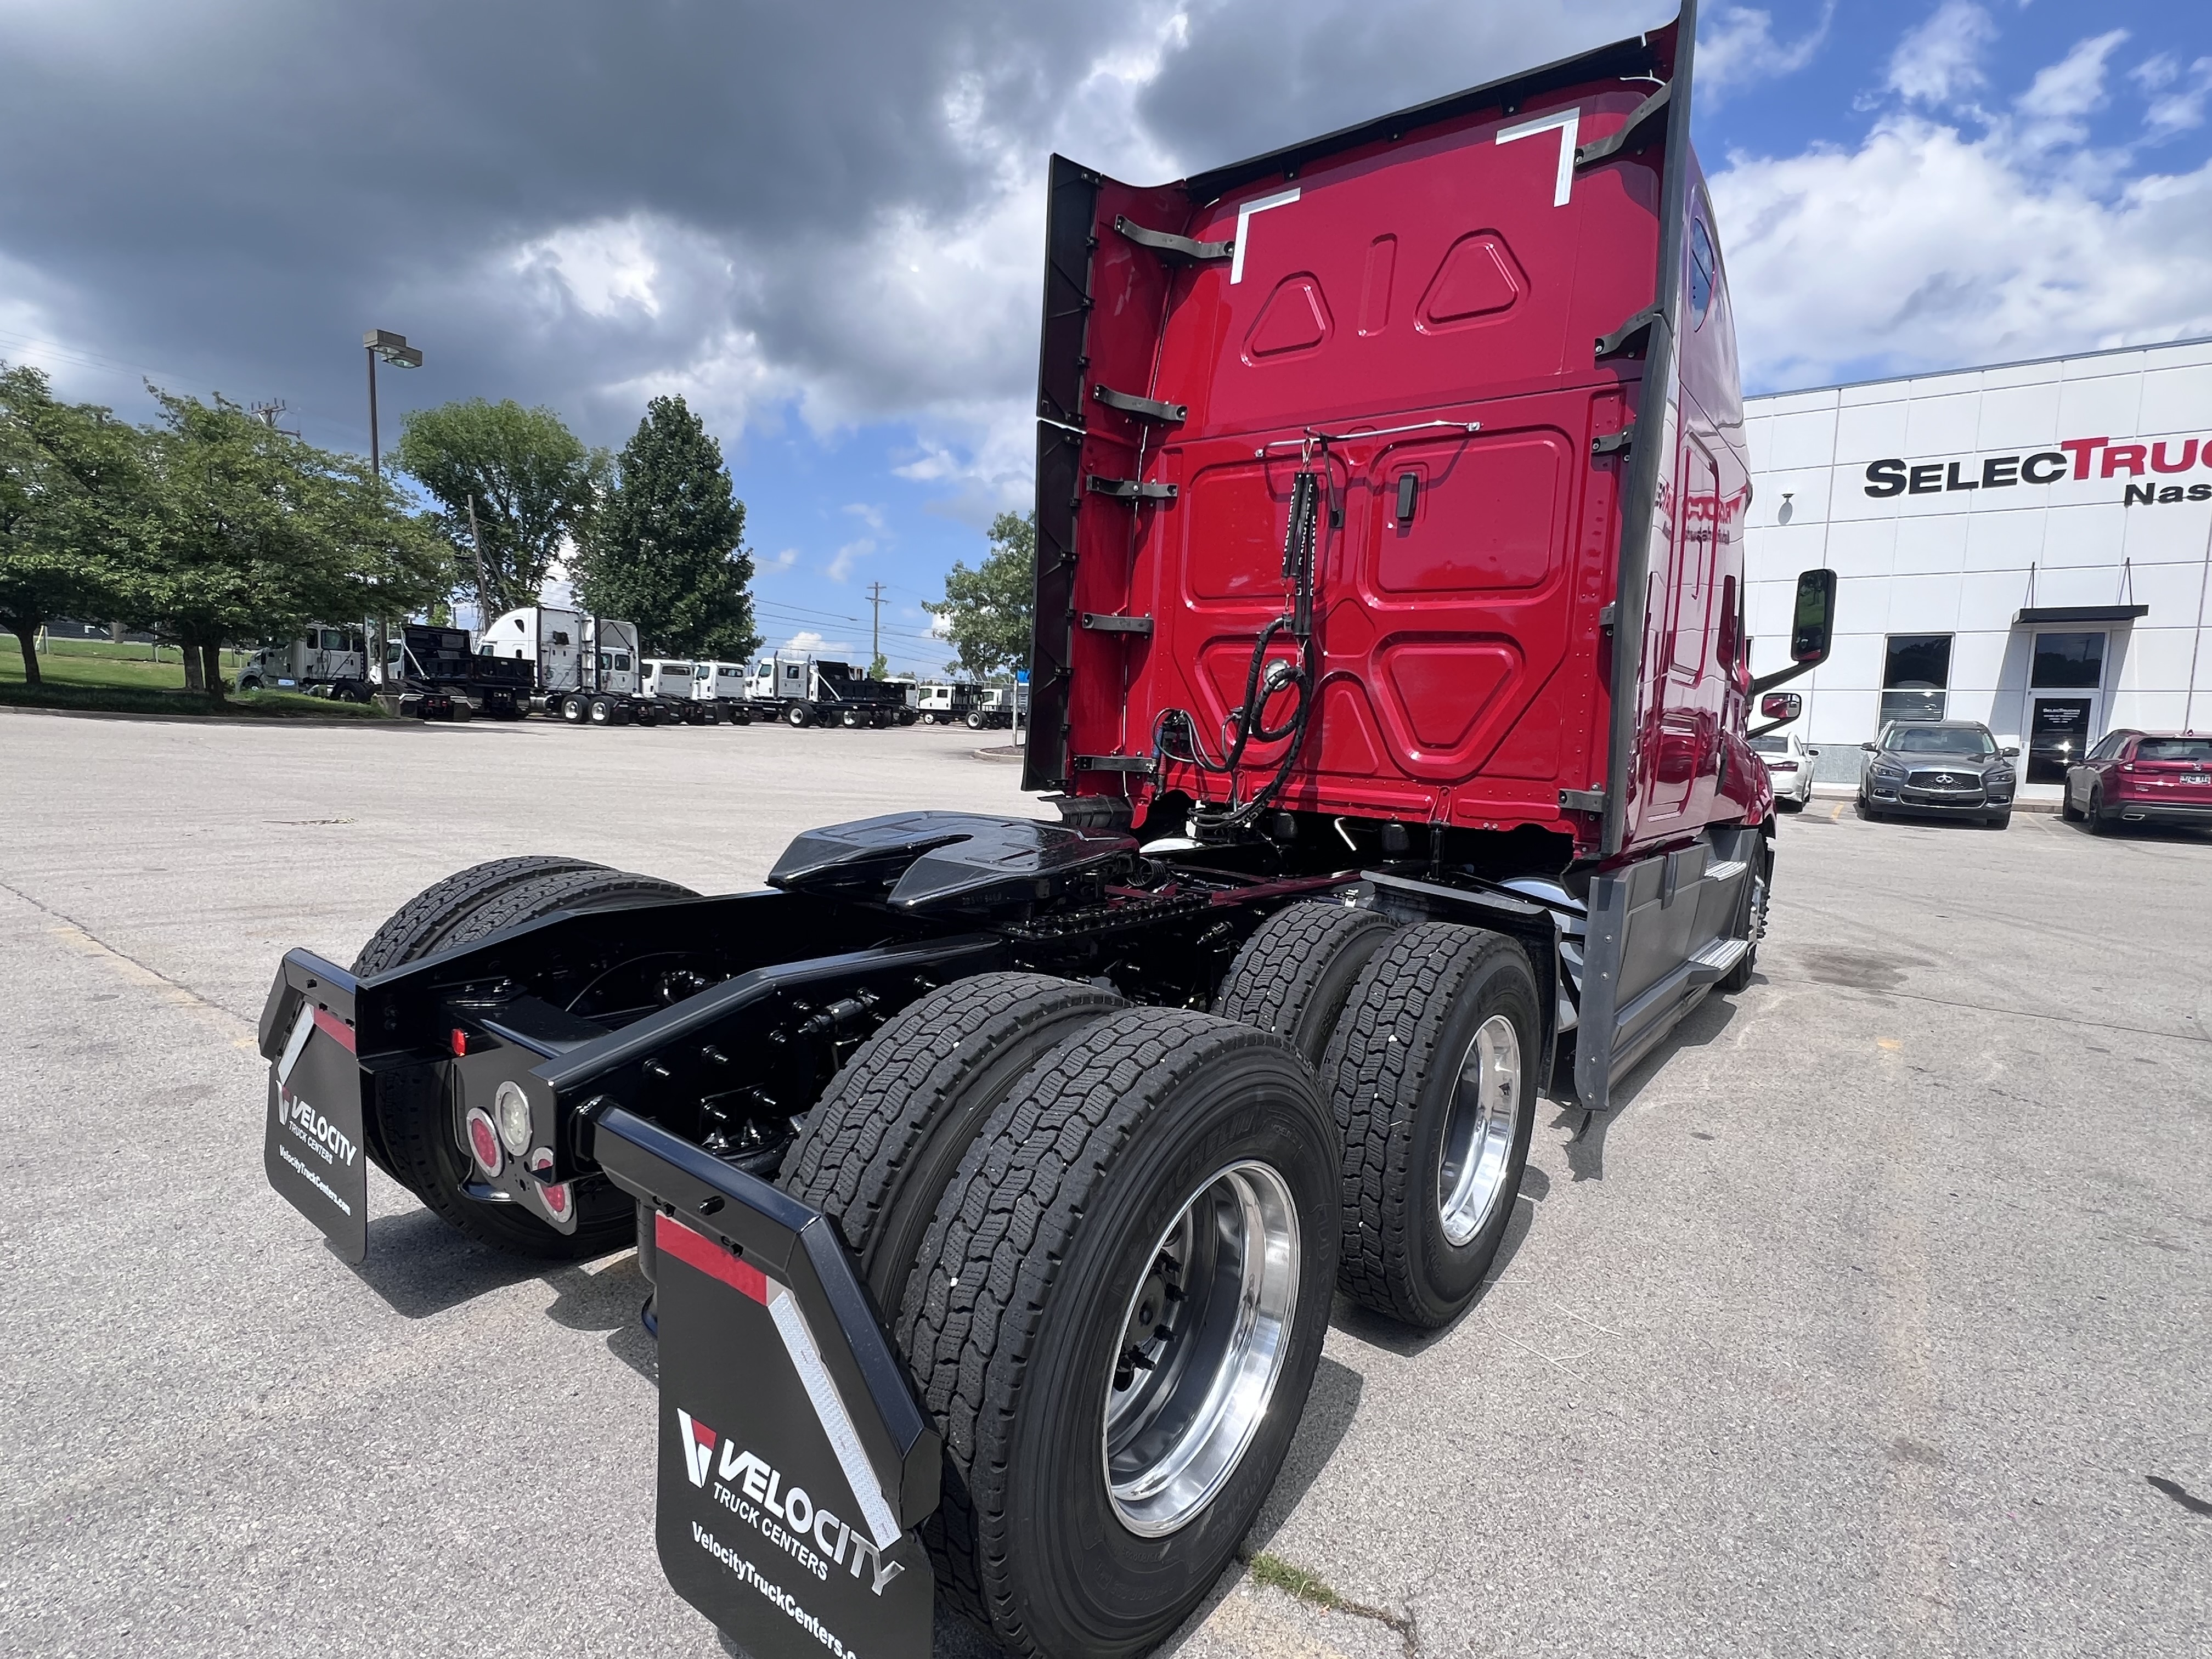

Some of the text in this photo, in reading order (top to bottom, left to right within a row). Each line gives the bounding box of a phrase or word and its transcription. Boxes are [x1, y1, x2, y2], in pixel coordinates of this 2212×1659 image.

[1865, 437, 2212, 498] SELECTRU
[289, 1120, 333, 1165] TRUCK CENTERS
[291, 1096, 357, 1166] VELOCITY
[714, 1482, 829, 1581] TRUCK CENTERS
[718, 1438, 905, 1596] VELOCITY
